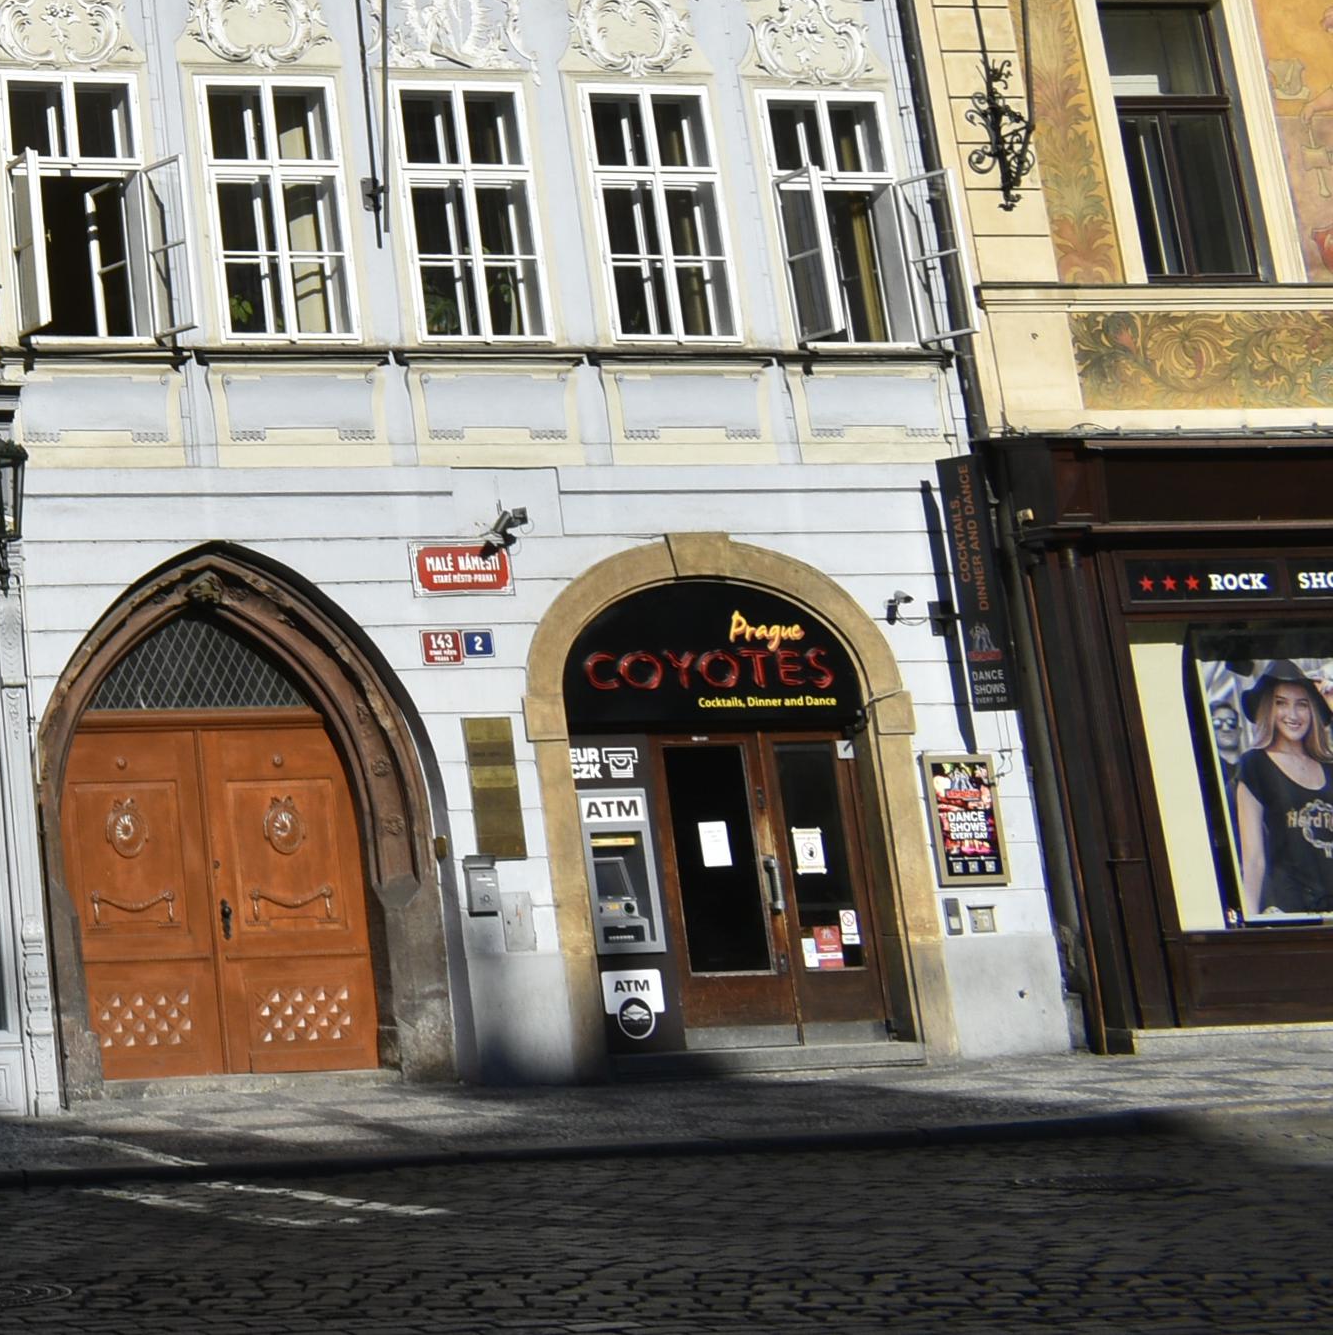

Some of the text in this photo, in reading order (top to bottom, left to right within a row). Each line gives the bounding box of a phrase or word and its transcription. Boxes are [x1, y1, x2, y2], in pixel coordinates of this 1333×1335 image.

[958, 463, 990, 611] DINNER AND DANCE
[425, 552, 454, 571] MALÉ
[1208, 572, 1267, 591] ROCK
[729, 610, 805, 651] Prague
[430, 633, 453, 649] 143
[474, 635, 483, 651] 2
[583, 646, 835, 690] COYOTES
[972, 669, 1004, 681] DANCE
[974, 683, 1006, 695] SHOWS
[698, 696, 837, 708] Cocktails, Dinner and Dance
[569, 747, 600, 763] EUR
[571, 763, 603, 779] CZK
[586, 799, 639, 819] ATM
[948, 810, 985, 822] DANCE
[949, 821, 987, 832] SHOWS
[951, 831, 988, 840] EVERY DAY
[614, 979, 650, 993] ATM
